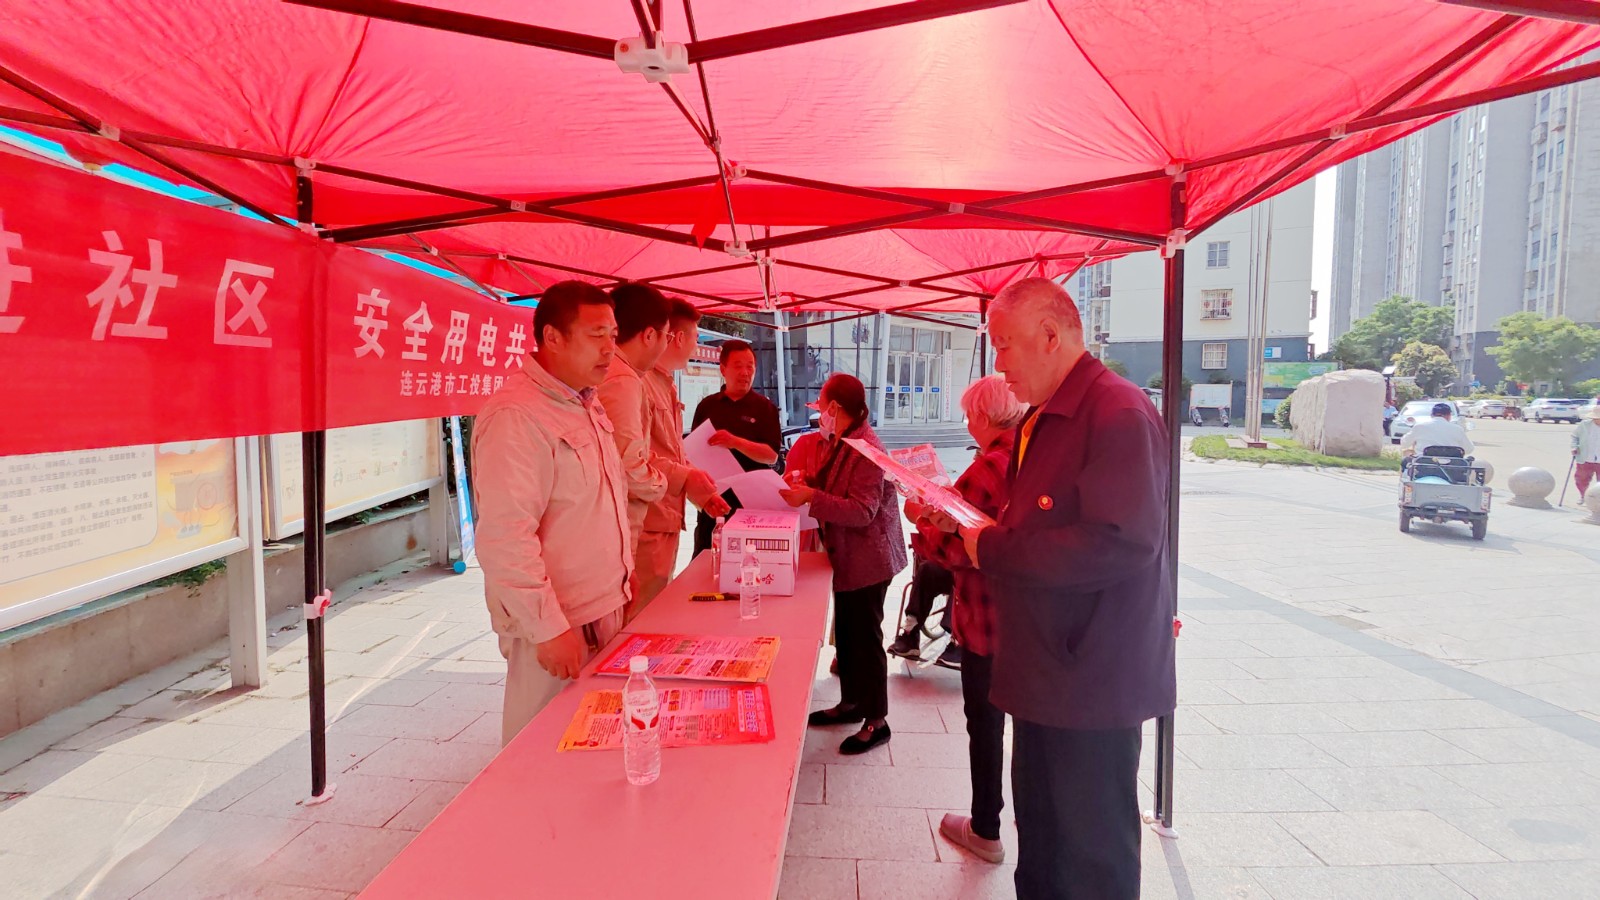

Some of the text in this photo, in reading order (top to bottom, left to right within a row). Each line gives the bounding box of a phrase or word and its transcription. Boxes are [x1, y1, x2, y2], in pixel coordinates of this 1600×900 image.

[353, 288, 538, 368] 安全用电共
[400, 370, 510, 396] 连云港市工投集团
